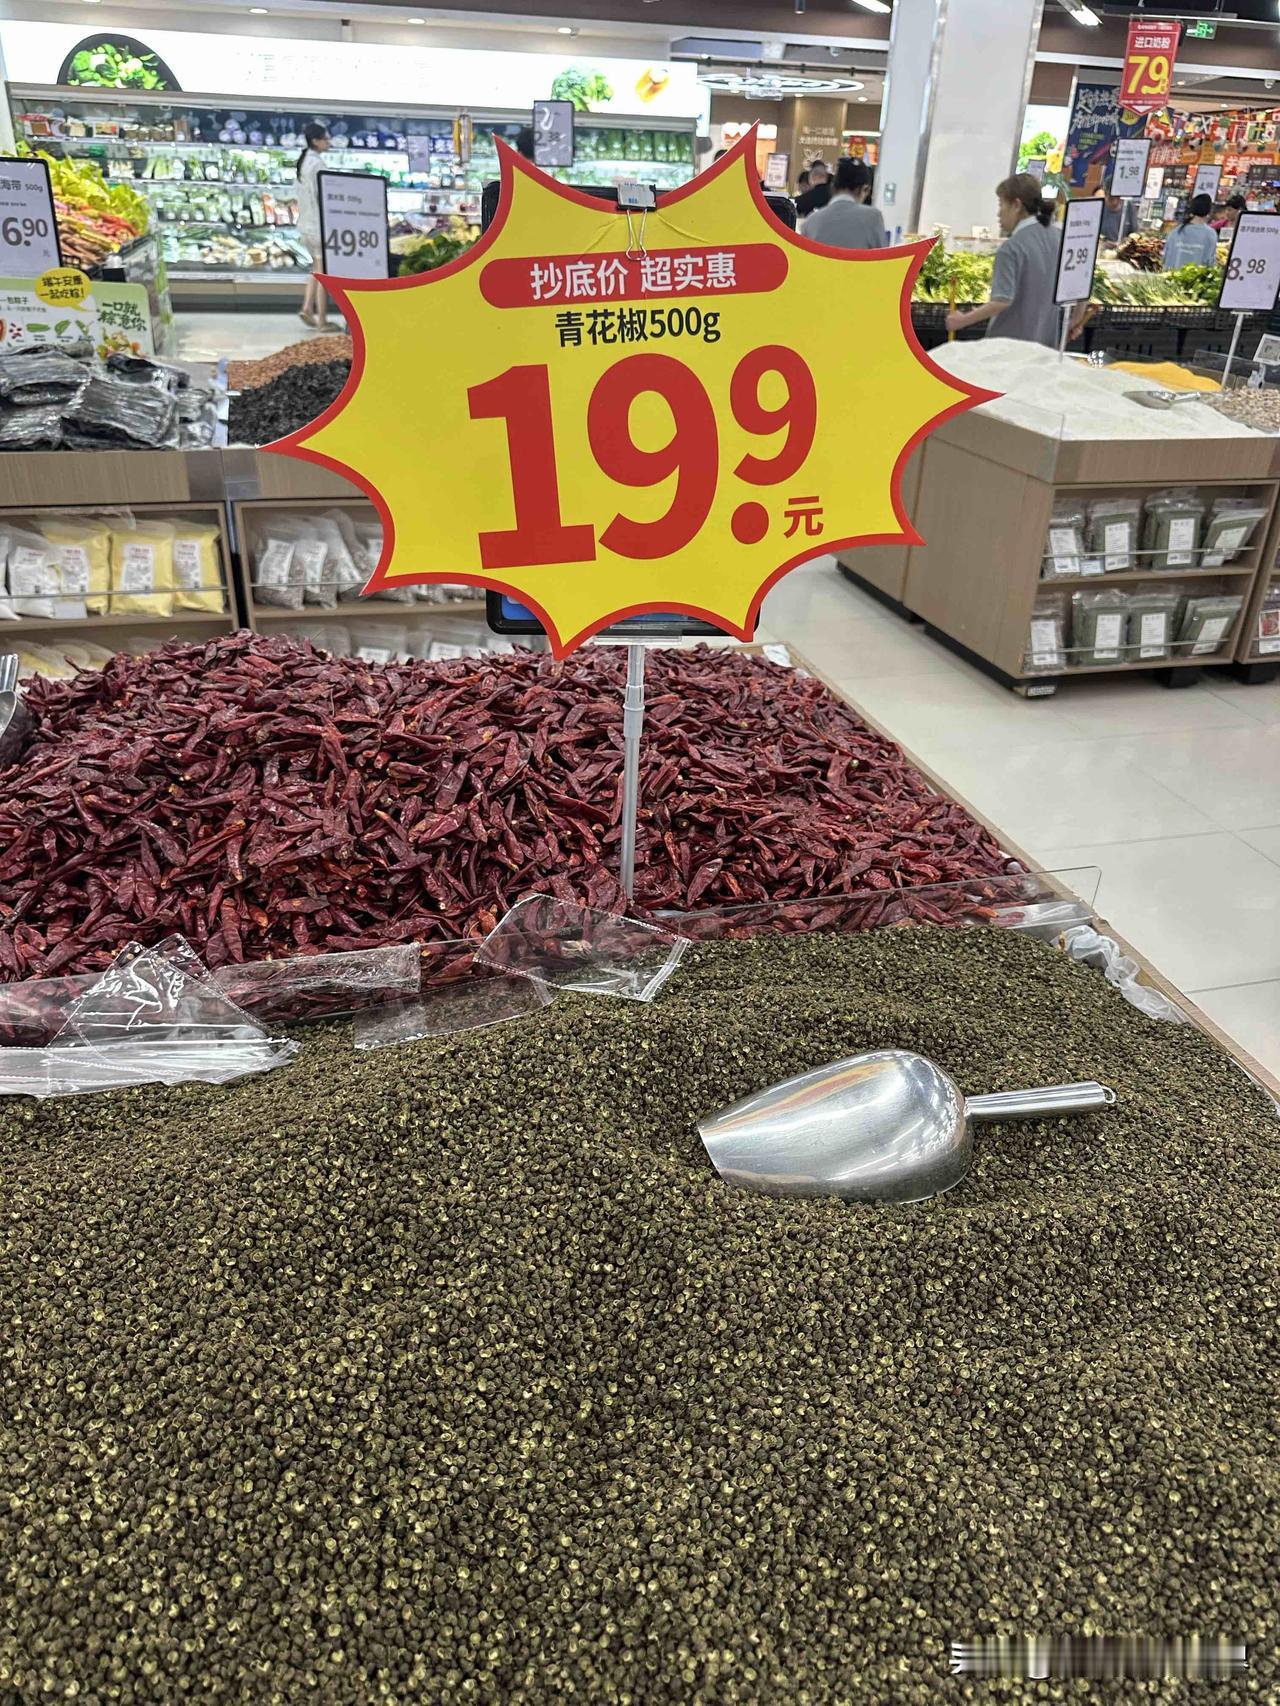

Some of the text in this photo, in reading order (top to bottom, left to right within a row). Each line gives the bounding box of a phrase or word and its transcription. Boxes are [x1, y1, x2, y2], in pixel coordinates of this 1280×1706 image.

[1127, 55, 1169, 95] 79
[2, 216, 49, 247] 6.90
[326, 229, 379, 258] 49.80
[530, 252, 737, 300] 抄底价 超实惠
[1064, 248, 1088, 271] 2.99
[1227, 257, 1266, 281] 8.98
[555, 306, 721, 347] 青花椒500g
[467, 344, 824, 570] 19.9 元
